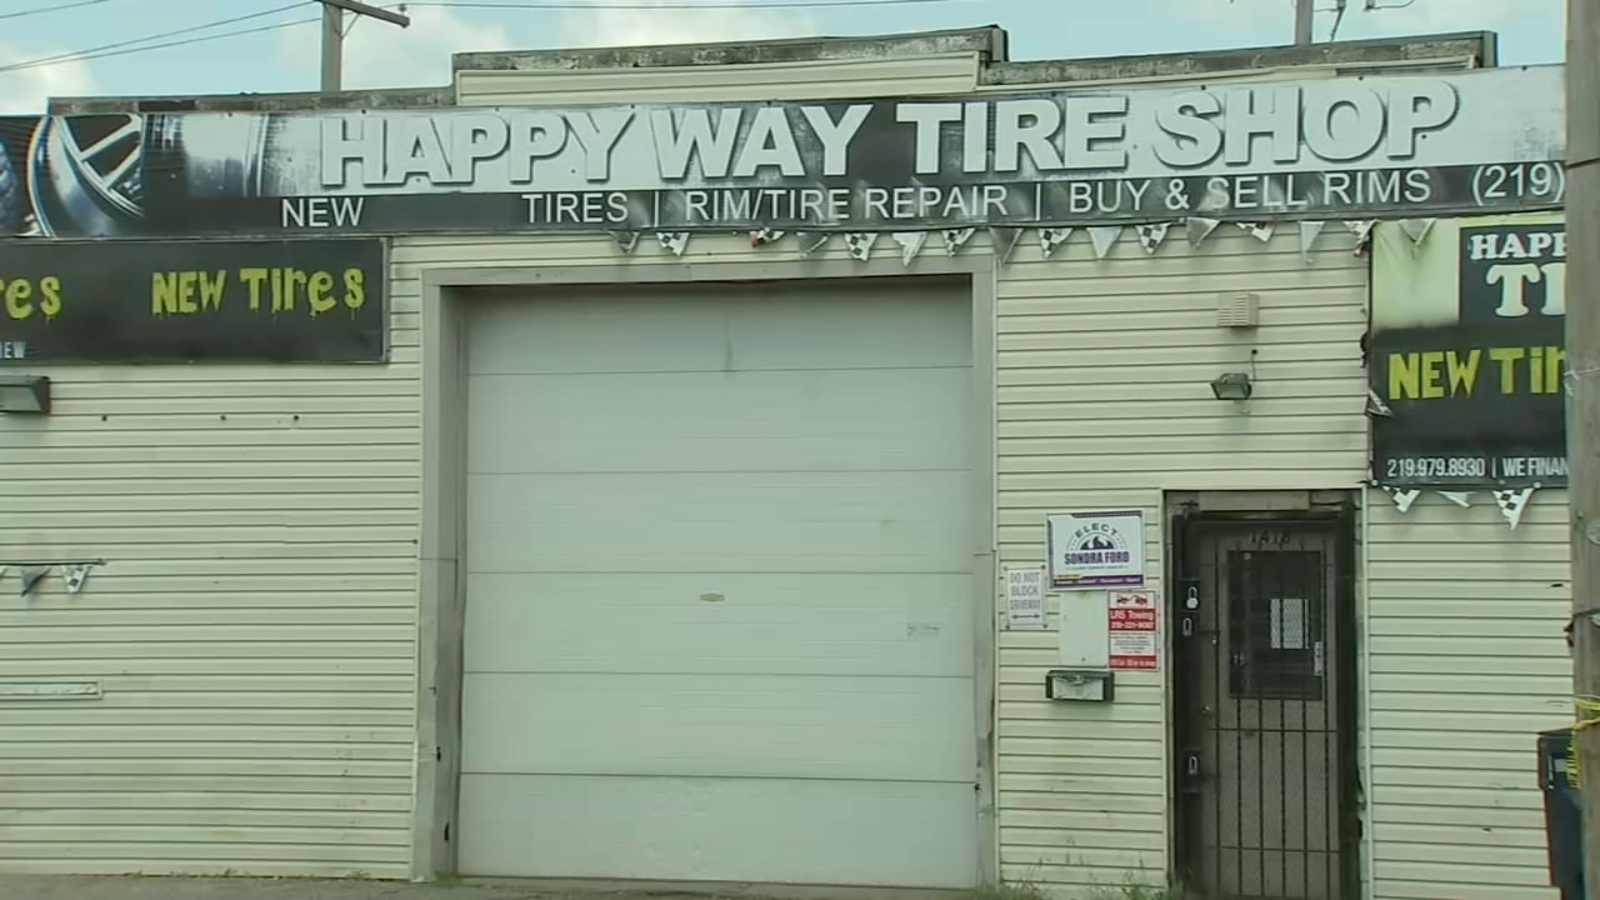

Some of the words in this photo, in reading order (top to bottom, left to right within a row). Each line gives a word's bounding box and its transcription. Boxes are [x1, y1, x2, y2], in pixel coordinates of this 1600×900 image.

[320, 107, 637, 187] HAPPY
[650, 102, 872, 181] WAY
[897, 95, 1128, 175] TIRE
[1153, 80, 1460, 166] SHOP
[281, 197, 364, 227] NEW
[521, 191, 629, 226] TIRES
[685, 187, 850, 222] RIM/TIRE
[865, 184, 1008, 219] REPAIR
[1069, 179, 1152, 214] BUY
[1165, 179, 1191, 210] &
[1207, 175, 1307, 210] SELL
[1323, 168, 1432, 206] RIMS
[1471, 162, 1563, 206] (219)
[152, 269, 225, 316] NEW
[1388, 349, 1482, 400] NEW
[1387, 457, 1486, 478] 219.979.8930
[1502, 458, 1526, 477] WE
[1075, 522, 1118, 538] ELECT
[1064, 551, 1103, 565] SONDRA
[1104, 550, 1130, 563] FORD
[1010, 572, 1021, 583] DO
[1023, 571, 1040, 583] NOT
[1011, 585, 1038, 596] BLOCK
[1127, 609, 1154, 621] Towing
